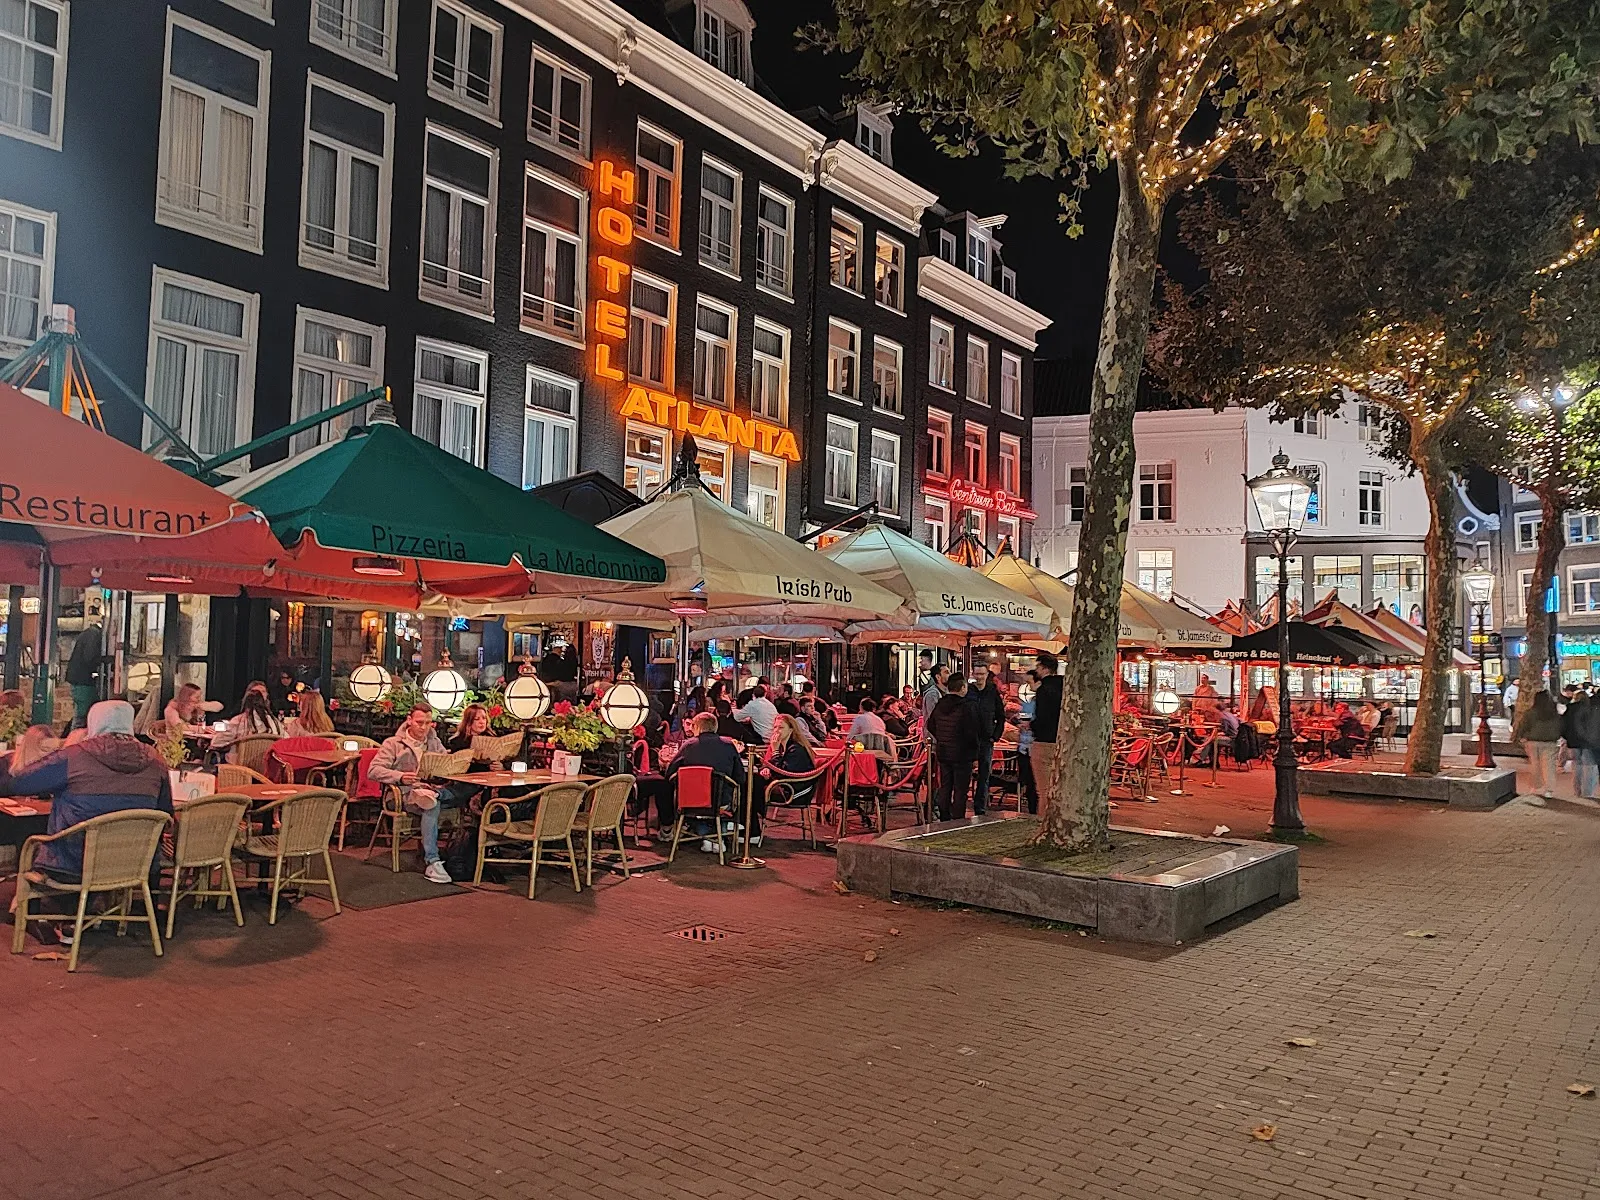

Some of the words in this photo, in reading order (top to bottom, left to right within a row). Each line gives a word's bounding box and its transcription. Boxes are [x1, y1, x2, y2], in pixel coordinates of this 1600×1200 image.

[594, 159, 635, 382] HOTEL
[619, 387, 802, 462] ATLANTA
[0, 483, 211, 534] Restaurant
[950, 479, 994, 508] Centrum
[994, 490, 1016, 513] Bar
[371, 524, 466, 560] Pizzeria
[528, 544, 549, 569] La
[555, 549, 661, 581] Madonnina
[776, 575, 821, 598] Irish
[824, 581, 852, 603] Pub
[1007, 601, 1034, 619] Gate
[1213, 649, 1249, 660] Burgers
[1249, 650, 1258, 658] &
[1296, 653, 1332, 663] Heineken
